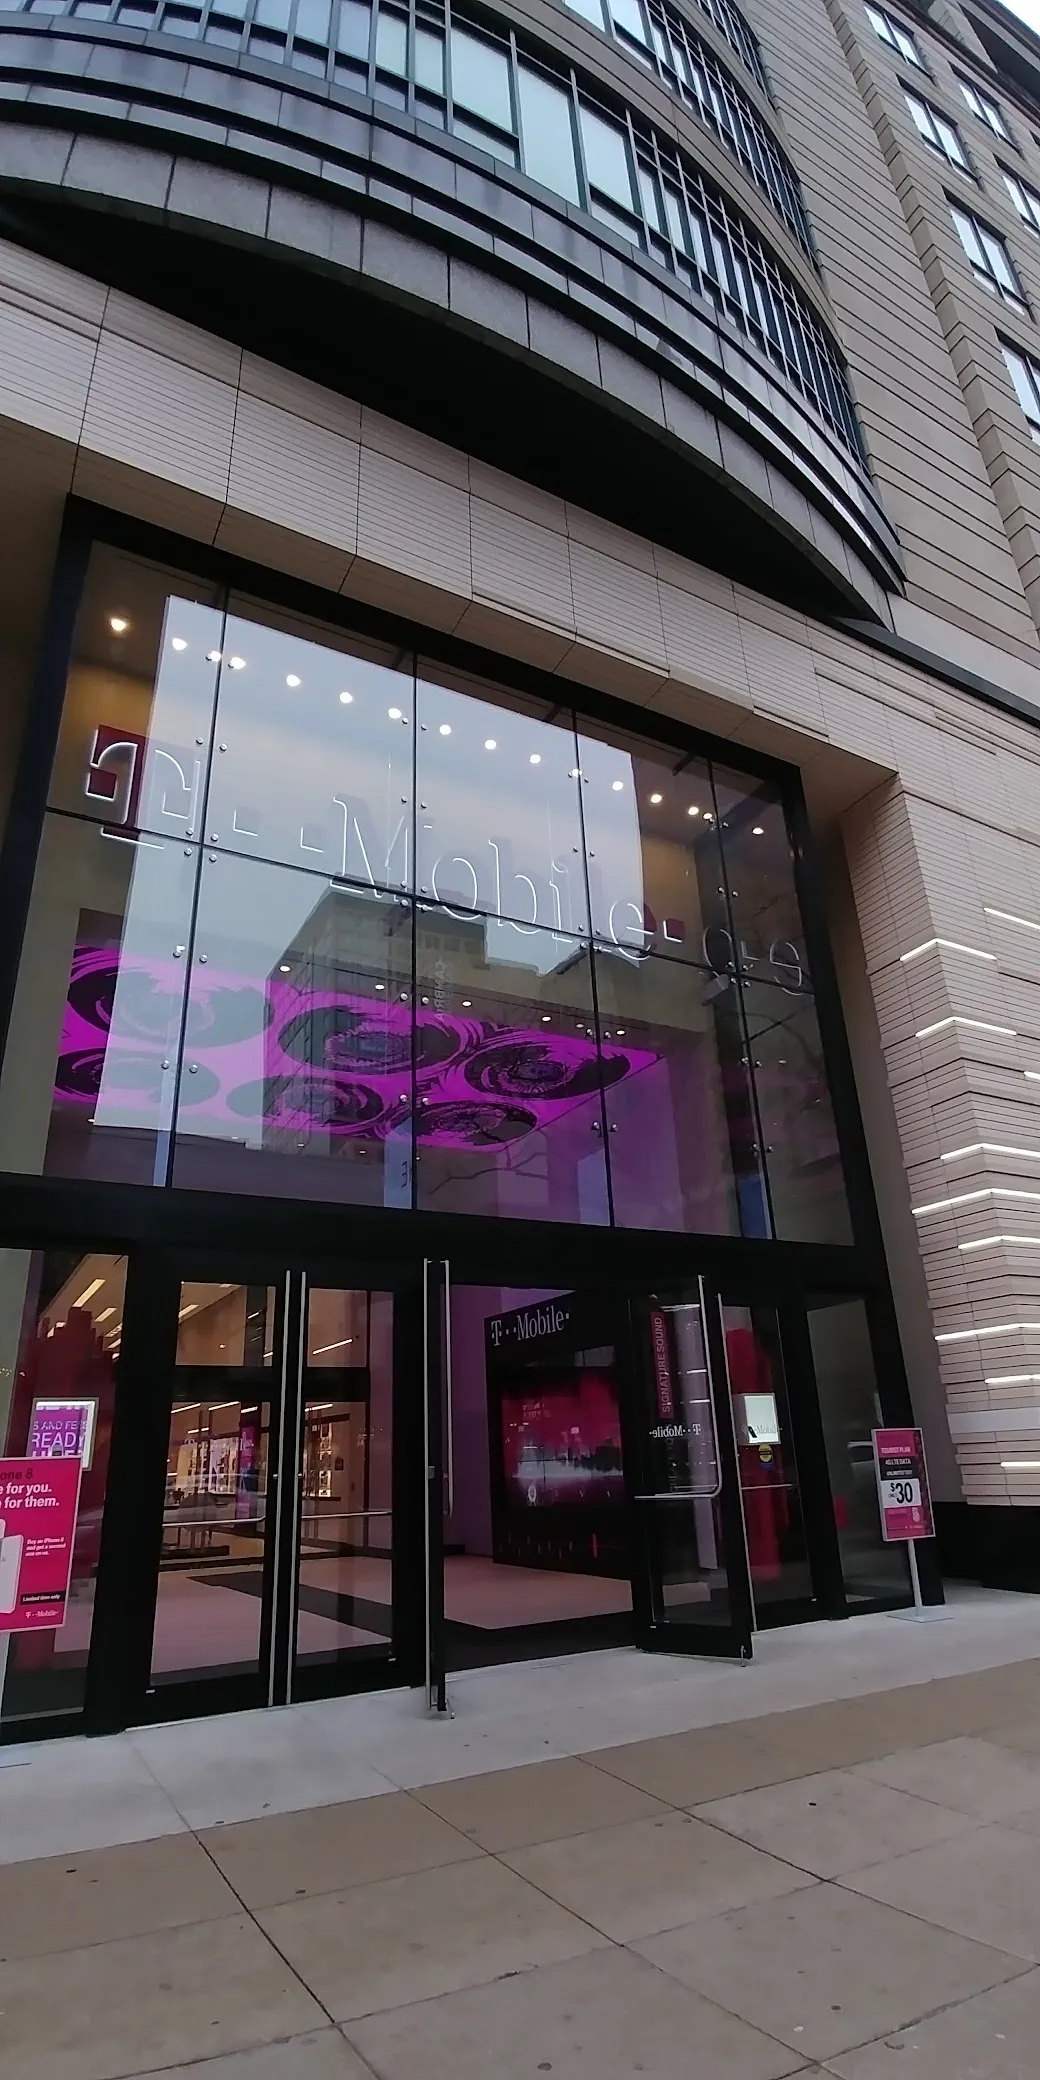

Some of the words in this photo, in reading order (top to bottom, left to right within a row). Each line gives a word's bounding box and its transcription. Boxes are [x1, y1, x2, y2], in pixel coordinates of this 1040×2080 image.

[653, 1317, 665, 1353] SOUND
[656, 1353, 671, 1413] SIGNATURE
[41, 1421, 63, 1430] AND
[6, 1482, 25, 1495] for
[26, 1483, 52, 1497] you.
[4, 1496, 23, 1509] for
[24, 1495, 60, 1508] them.
